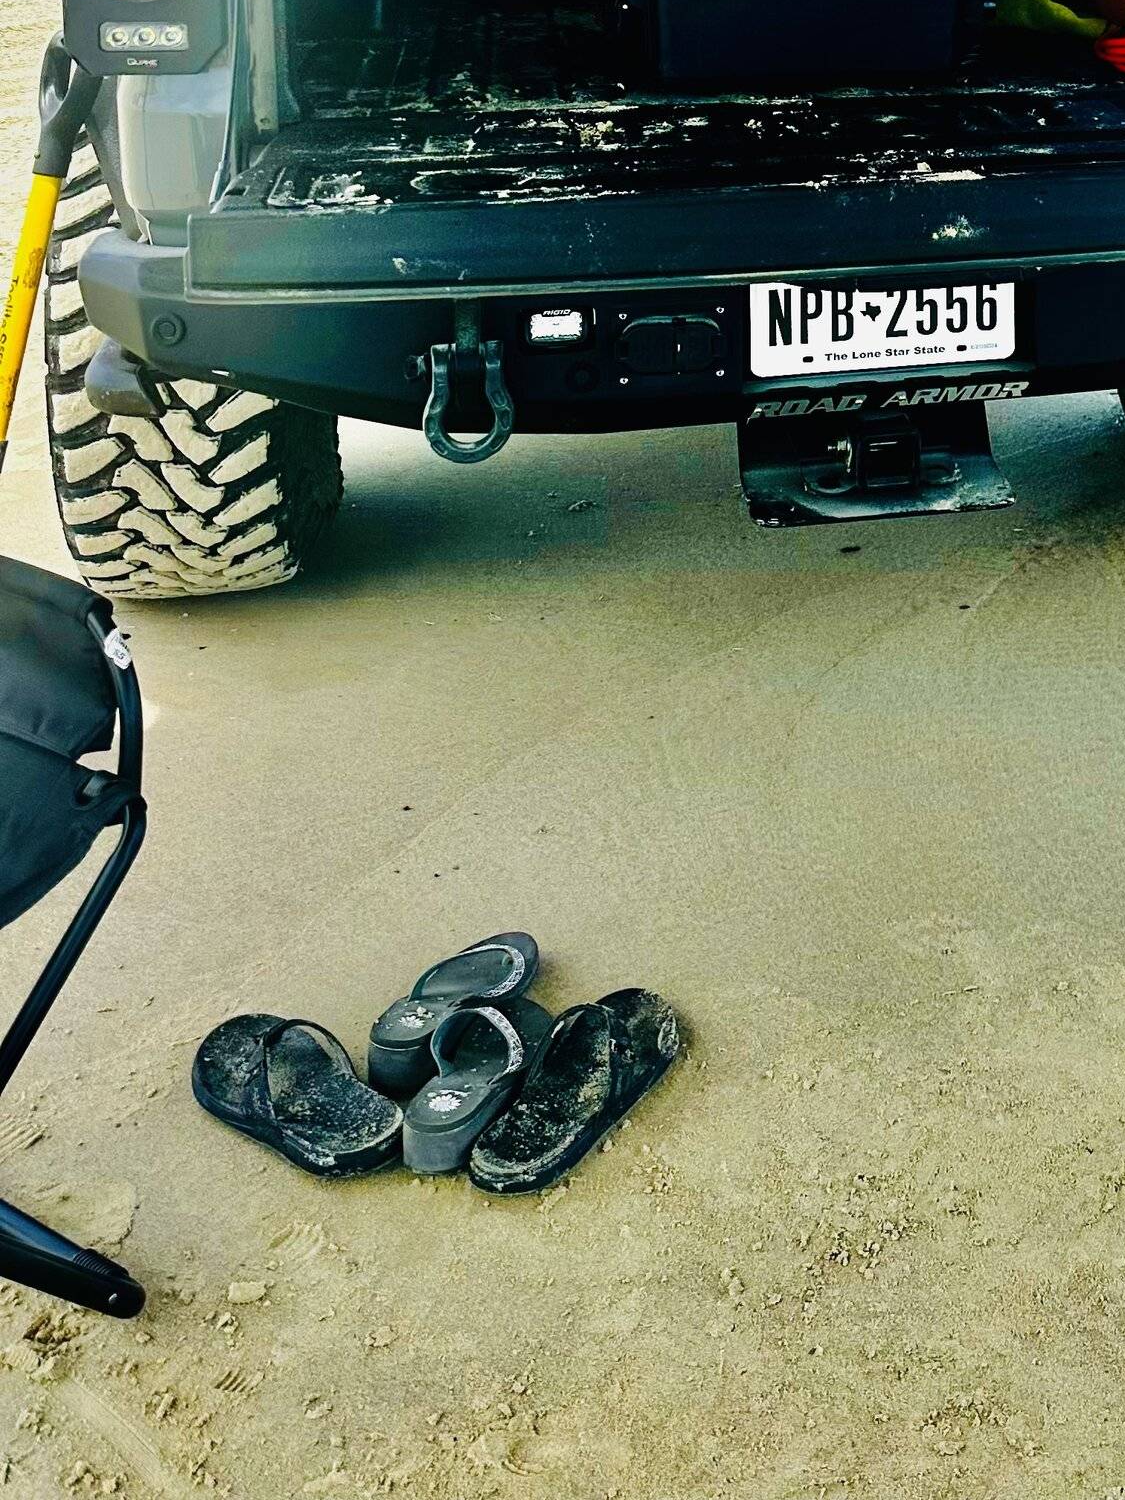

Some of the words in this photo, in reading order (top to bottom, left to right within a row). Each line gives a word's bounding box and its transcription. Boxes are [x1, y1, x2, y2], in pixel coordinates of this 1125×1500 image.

[542, 308, 572, 316] RIGID
[768, 287, 854, 347] NPB
[885, 283, 998, 339] 2556
[825, 351, 848, 362] The
[852, 349, 882, 361] Lone
[885, 347, 910, 357] Star
[913, 344, 946, 356] State
[746, 394, 867, 425] ROAD
[880, 380, 1030, 409] ARMOR
